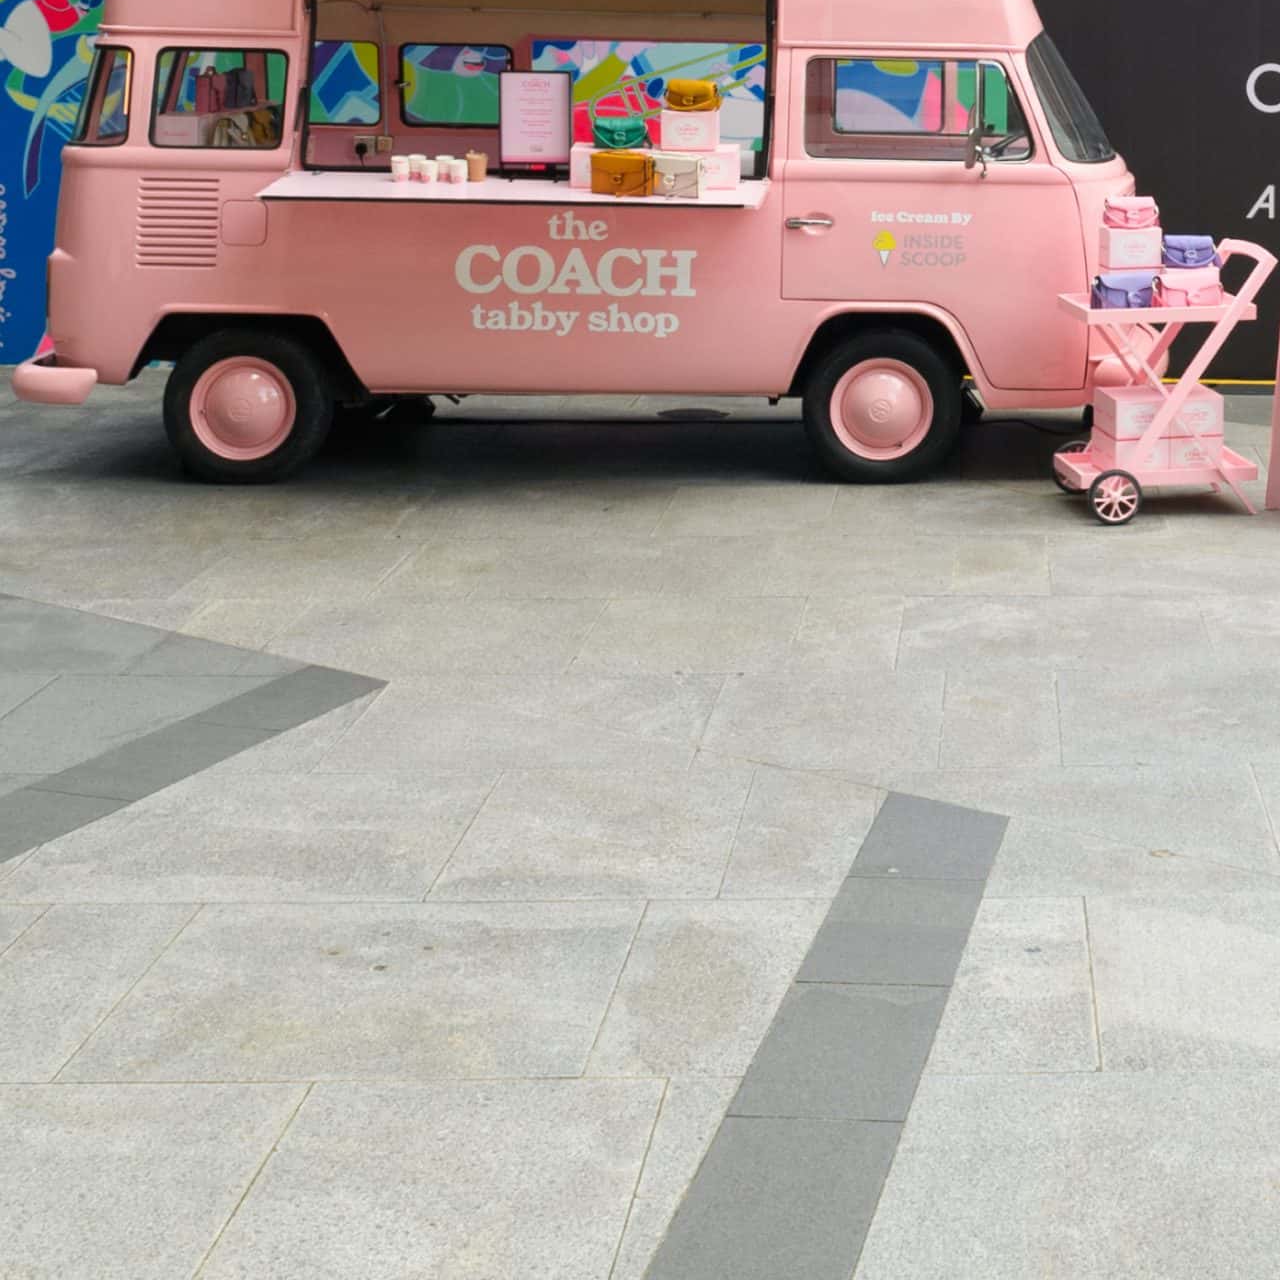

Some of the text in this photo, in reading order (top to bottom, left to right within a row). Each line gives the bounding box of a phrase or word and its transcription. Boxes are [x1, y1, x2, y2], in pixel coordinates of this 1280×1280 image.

[1246, 184, 1276, 220] A
[548, 211, 609, 240] the
[871, 211, 973, 226] Ice Cream By
[902, 233, 965, 250] INSIDE
[455, 244, 698, 297] COACH
[900, 251, 967, 267] SCOOP
[470, 301, 681, 338] tabby shop
